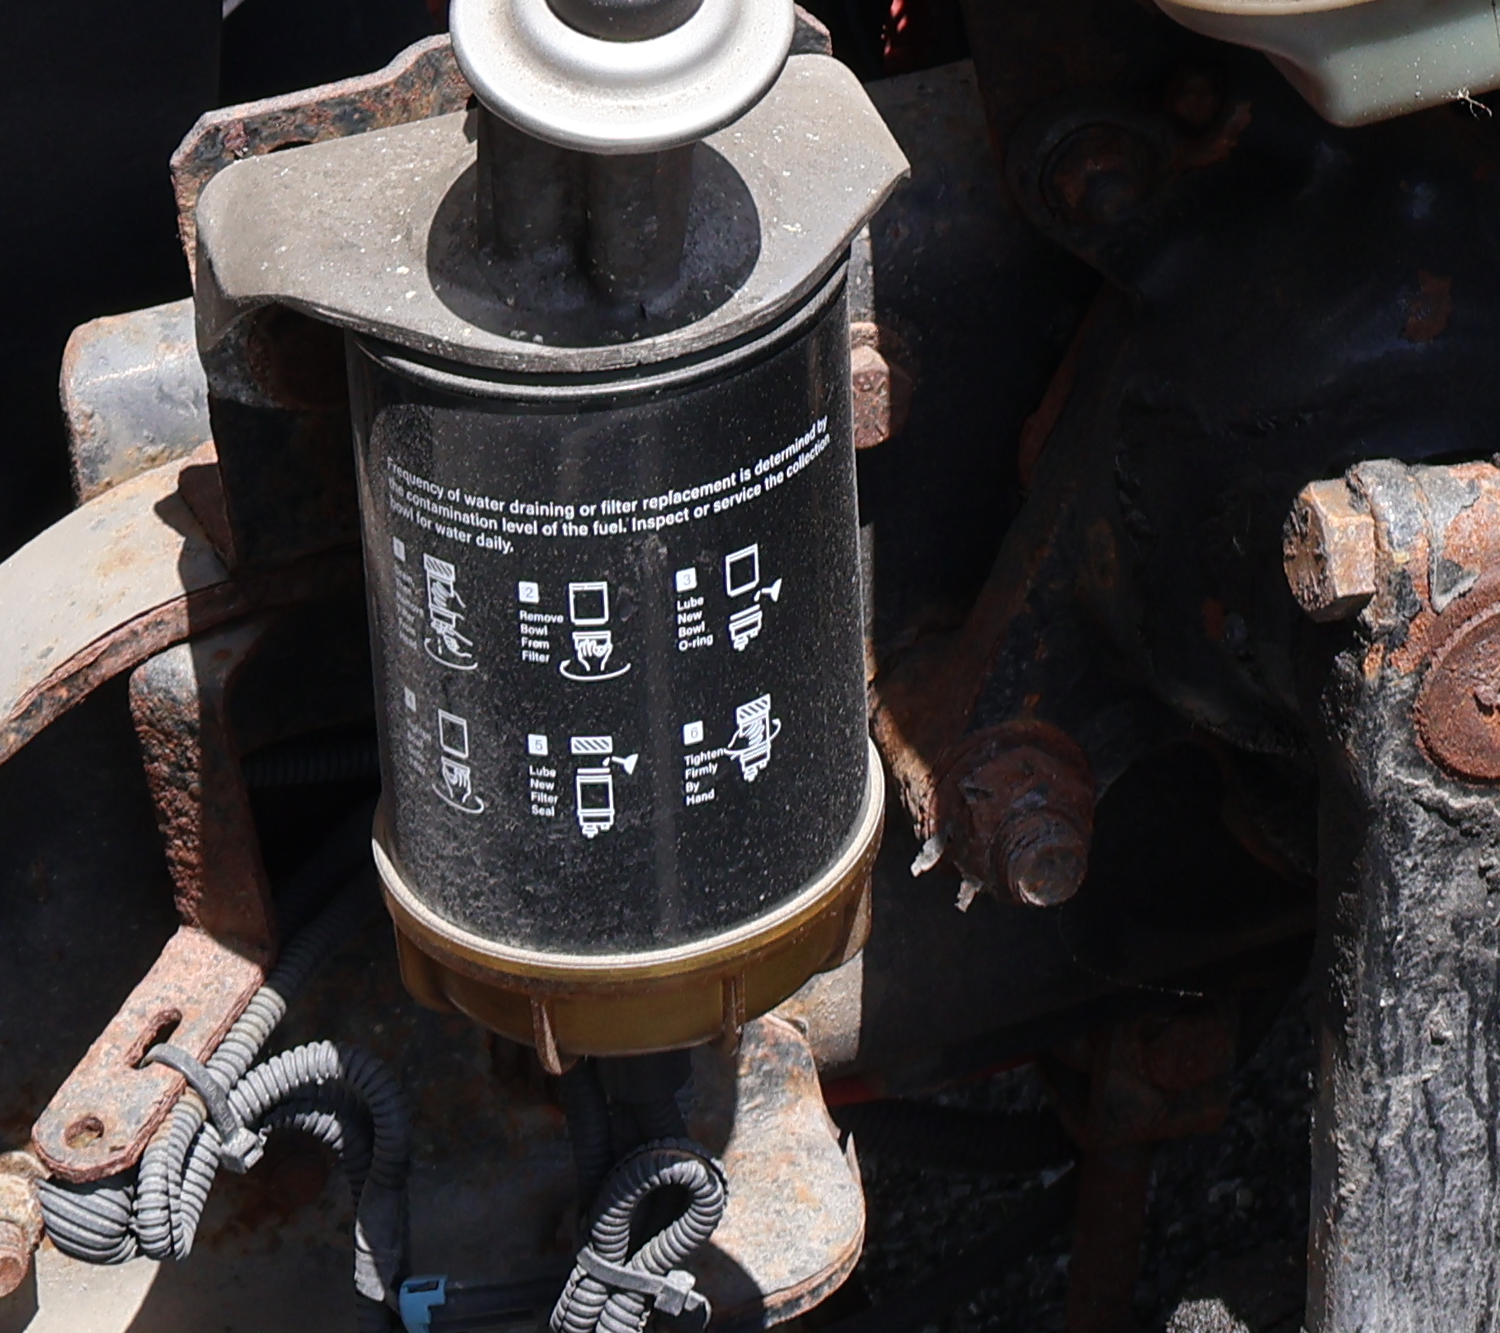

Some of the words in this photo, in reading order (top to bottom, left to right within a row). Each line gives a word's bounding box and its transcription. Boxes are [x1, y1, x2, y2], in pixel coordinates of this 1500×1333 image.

[387, 456, 443, 500] Frequency
[447, 489, 460, 503] of
[464, 493, 505, 513] water
[510, 499, 575, 520] draining
[579, 503, 597, 517] or
[601, 498, 638, 515] filter
[643, 472, 736, 511] replacement
[739, 467, 751, 482] is
[754, 429, 816, 476] determined
[817, 415, 828, 434] by
[388, 477, 404, 497] the
[406, 487, 498, 531] contamination
[502, 517, 538, 534] level
[542, 520, 557, 536] of
[561, 520, 589, 536] the
[593, 518, 627, 535] fuel.
[632, 506, 689, 532] Inspect
[694, 501, 710, 517] or
[714, 484, 762, 513] service
[764, 471, 783, 492] the
[786, 433, 831, 478] collection
[389, 495, 414, 522] bowl
[416, 510, 431, 530] for
[434, 521, 472, 545] water
[476, 533, 514, 555] daily.
[677, 597, 704, 611] Lube
[519, 610, 564, 623] Remove
[677, 610, 702, 624] New
[520, 623, 548, 636] Bowl
[678, 621, 705, 638] Bowl
[521, 637, 550, 649] From
[679, 634, 713, 651] O-ring
[522, 650, 550, 663] Filter
[684, 747, 724, 766] Tighten
[529, 765, 556, 778] Lube
[685, 762, 718, 780] Firmly
[530, 778, 555, 790] New
[685, 781, 699, 793] By
[531, 791, 559, 804] Filter
[686, 788, 715, 806] Hand
[531, 804, 555, 817] Seal
